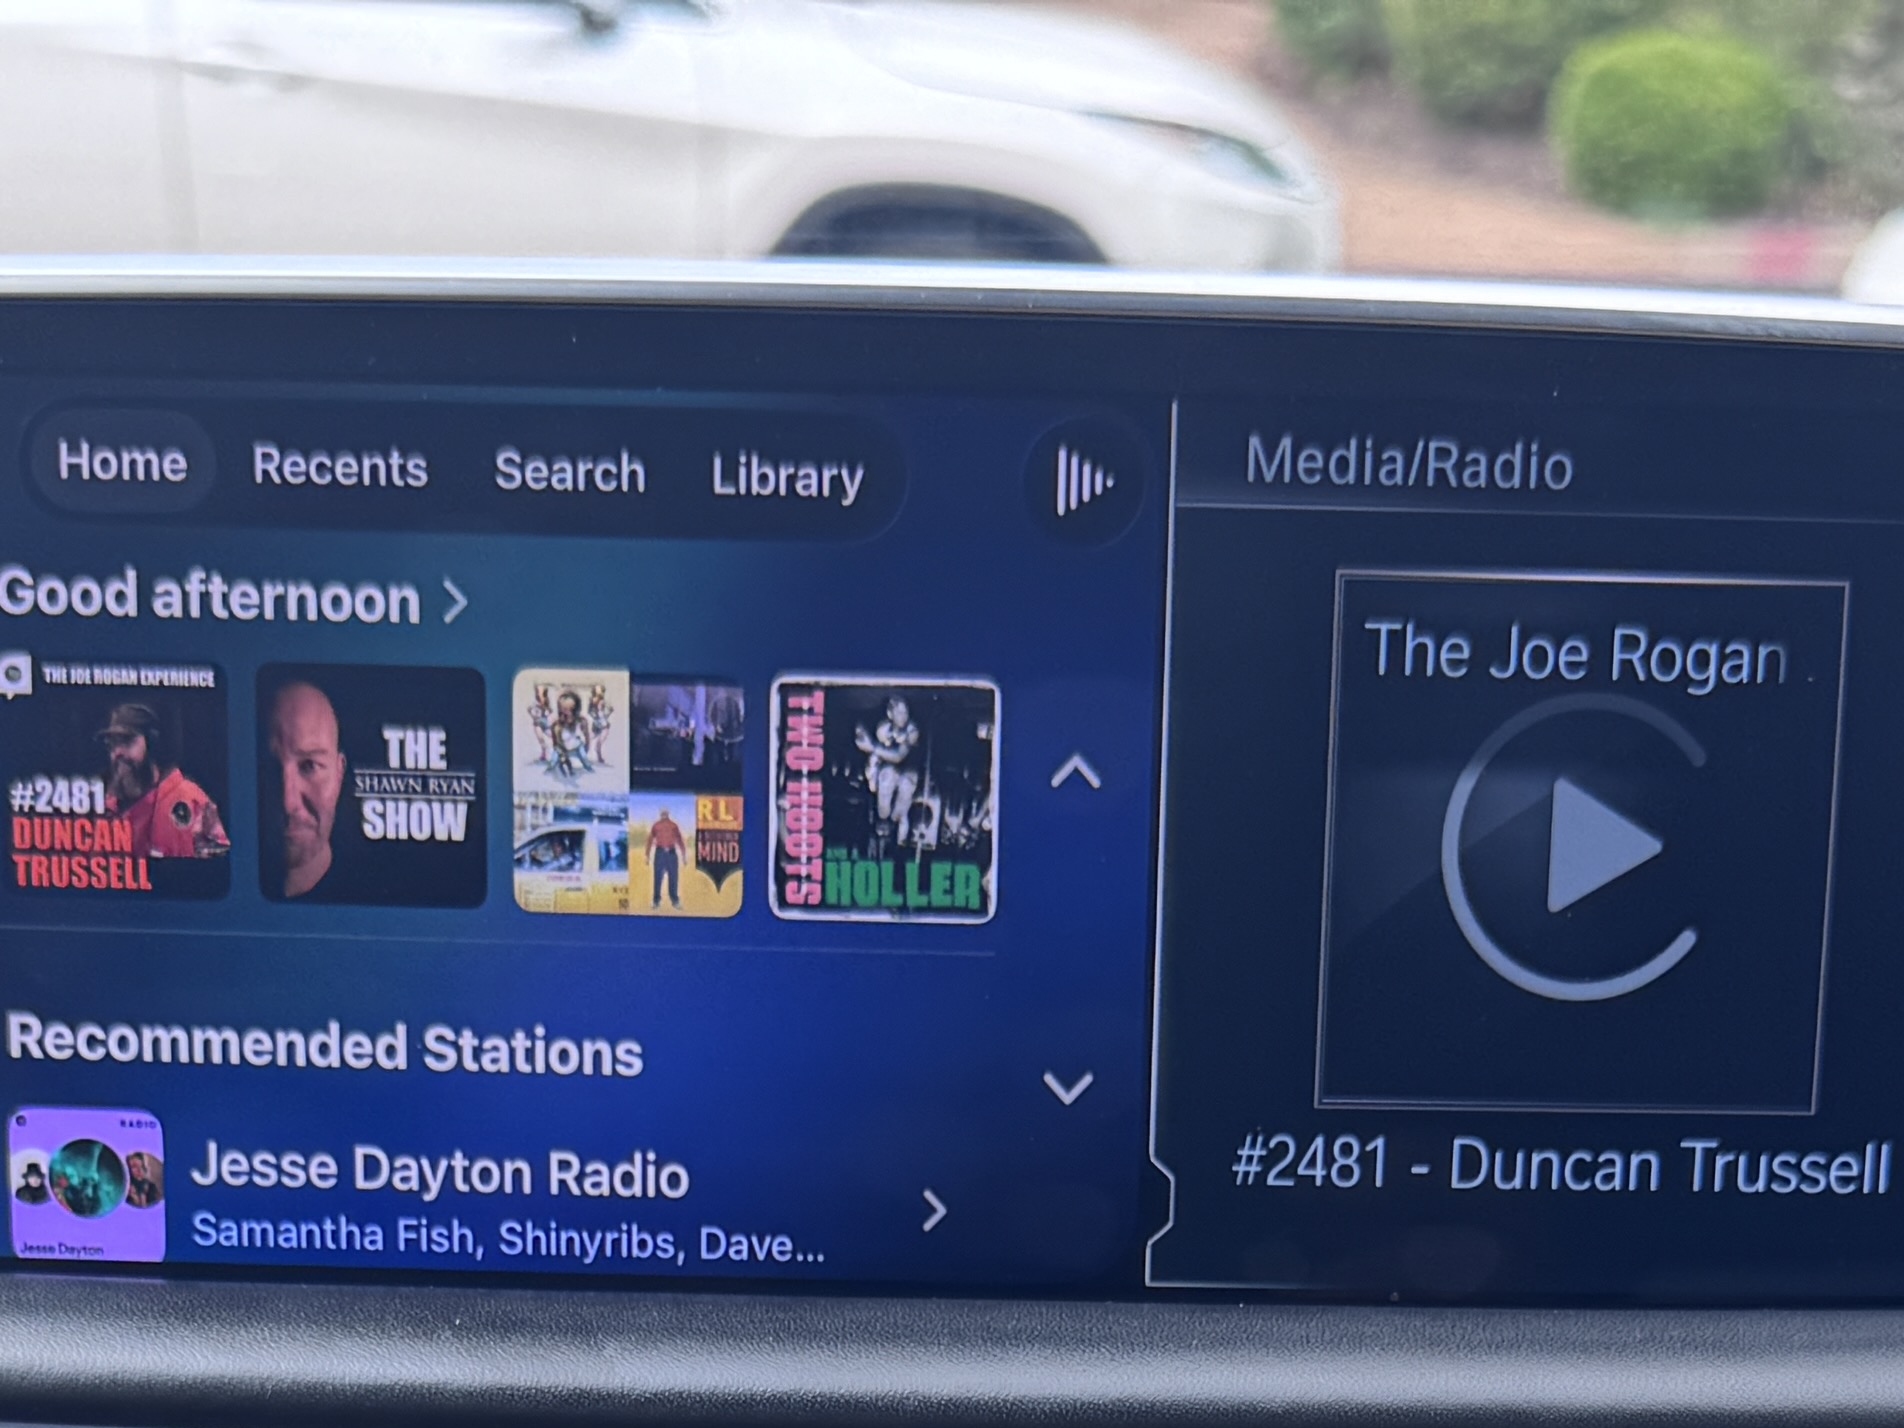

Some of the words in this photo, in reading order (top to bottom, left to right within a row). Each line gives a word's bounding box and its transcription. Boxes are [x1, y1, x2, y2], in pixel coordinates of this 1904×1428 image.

[58, 439, 188, 482] Home
[253, 442, 428, 487] Recents
[496, 447, 645, 492] Search
[713, 452, 863, 506] Library
[1246, 433, 1574, 490] Media/Radio
[152, 569, 420, 624] afternoon
[43, 663, 69, 684] THE
[71, 665, 92, 684] JOE
[94, 666, 137, 686] ROGAN
[141, 668, 215, 688] EXPERIENCE
[1365, 617, 1470, 679] The
[1488, 621, 1589, 680] Joe
[1611, 625, 1786, 695] Rogan
[382, 726, 447, 770] THE
[786, 690, 825, 771] TWO
[9, 776, 105, 815] #2481
[355, 775, 422, 793] SHAWN
[429, 777, 475, 795] RYAN
[12, 817, 133, 853] DUNCAN
[362, 799, 468, 841] SHOW
[698, 841, 739, 863] MIND
[785, 781, 824, 905] HOOTS
[12, 853, 152, 890] TRUSSELL
[825, 860, 980, 909] HOLLER
[7, 1011, 407, 1070] Recommended
[422, 1025, 643, 1078] Stations
[120, 1119, 157, 1129] RADIO
[191, 1139, 337, 1189] Jesse
[355, 1145, 531, 1201] Dayton
[548, 1150, 690, 1199] Radio
[1232, 1134, 1387, 1188] #2481
[1410, 1163, 1430, 1174] -
[1450, 1137, 1659, 1191] Duncan
[1680, 1139, 1892, 1194] Trussell
[21, 1241, 56, 1254] Jesse
[58, 1243, 104, 1257] Dayton
[192, 1212, 384, 1252] Samantha
[397, 1219, 484, 1261] Fish,
[499, 1222, 685, 1265] Shinyribs,
[699, 1226, 825, 1262] Dave...
